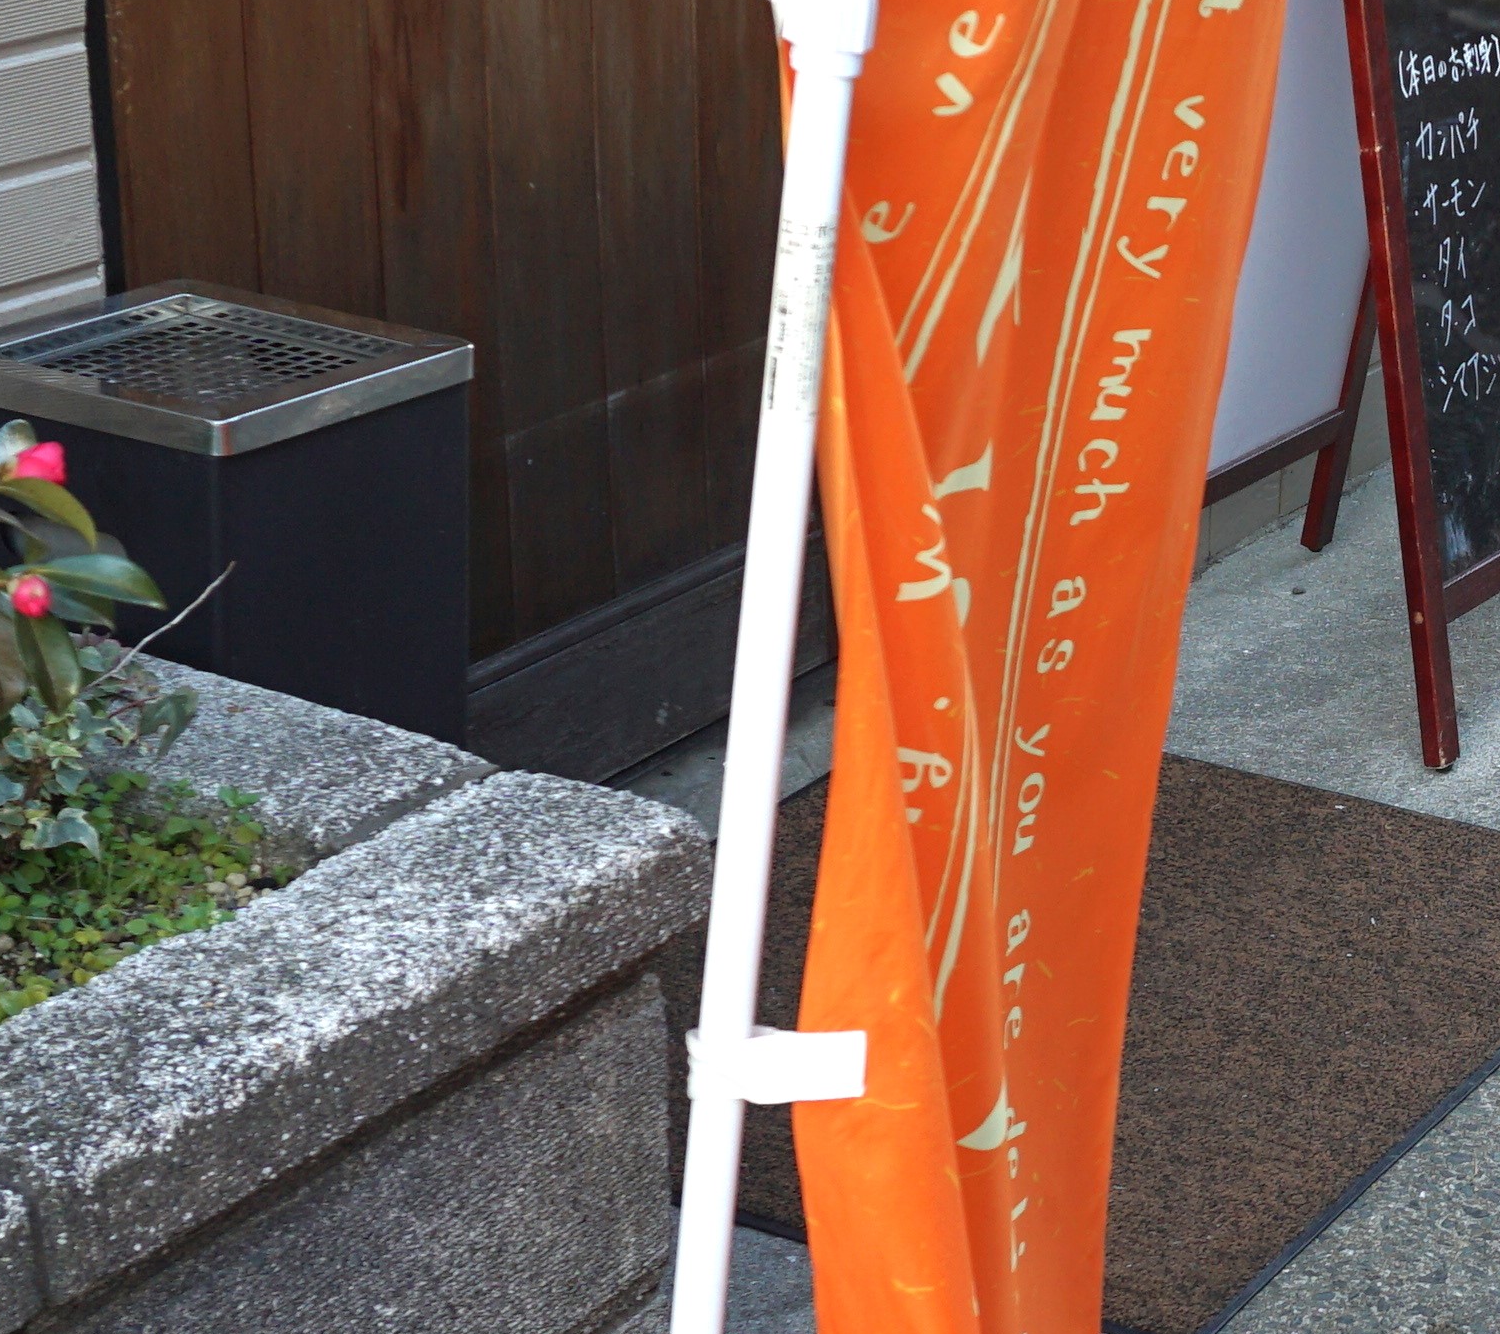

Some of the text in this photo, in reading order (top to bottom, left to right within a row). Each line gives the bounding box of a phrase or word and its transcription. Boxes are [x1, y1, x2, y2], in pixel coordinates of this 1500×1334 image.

[1117, 94, 1206, 281] very
[1415, 106, 1480, 161] カンパチ
[1070, 327, 1152, 527] much
[1036, 575, 1088, 675] as
[1011, 723, 1053, 857] you
[1002, 907, 1031, 1052] are
